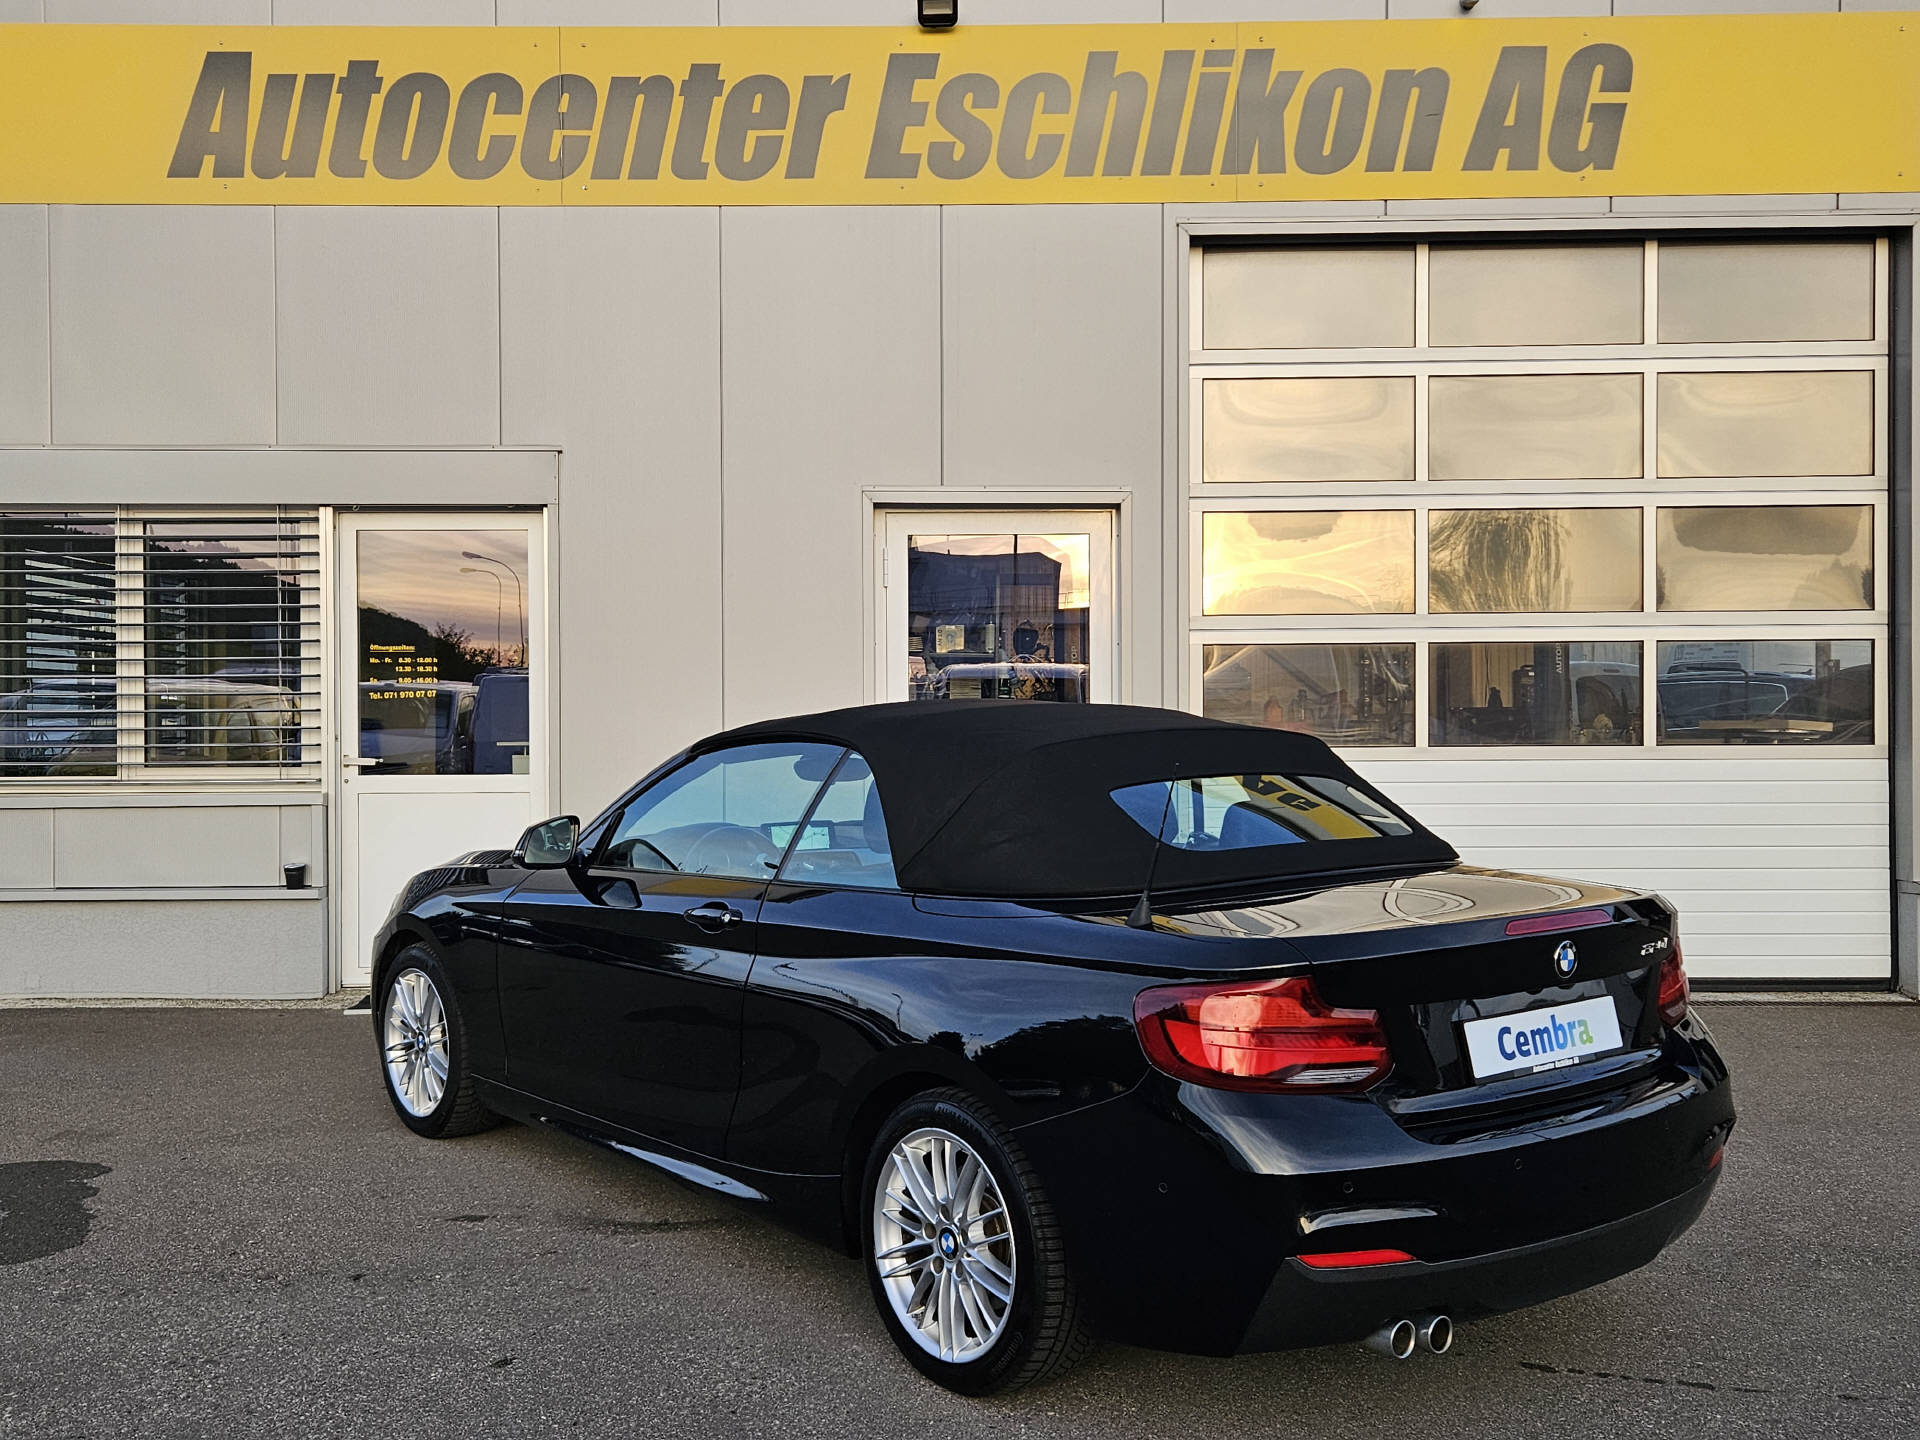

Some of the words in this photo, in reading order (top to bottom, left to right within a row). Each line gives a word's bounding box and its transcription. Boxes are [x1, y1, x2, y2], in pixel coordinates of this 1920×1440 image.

[166, 51, 851, 181] Autocenter
[864, 48, 1450, 180] Eschlikon
[1461, 42, 1634, 173] AG
[1498, 1014, 1593, 1061] Cembra
